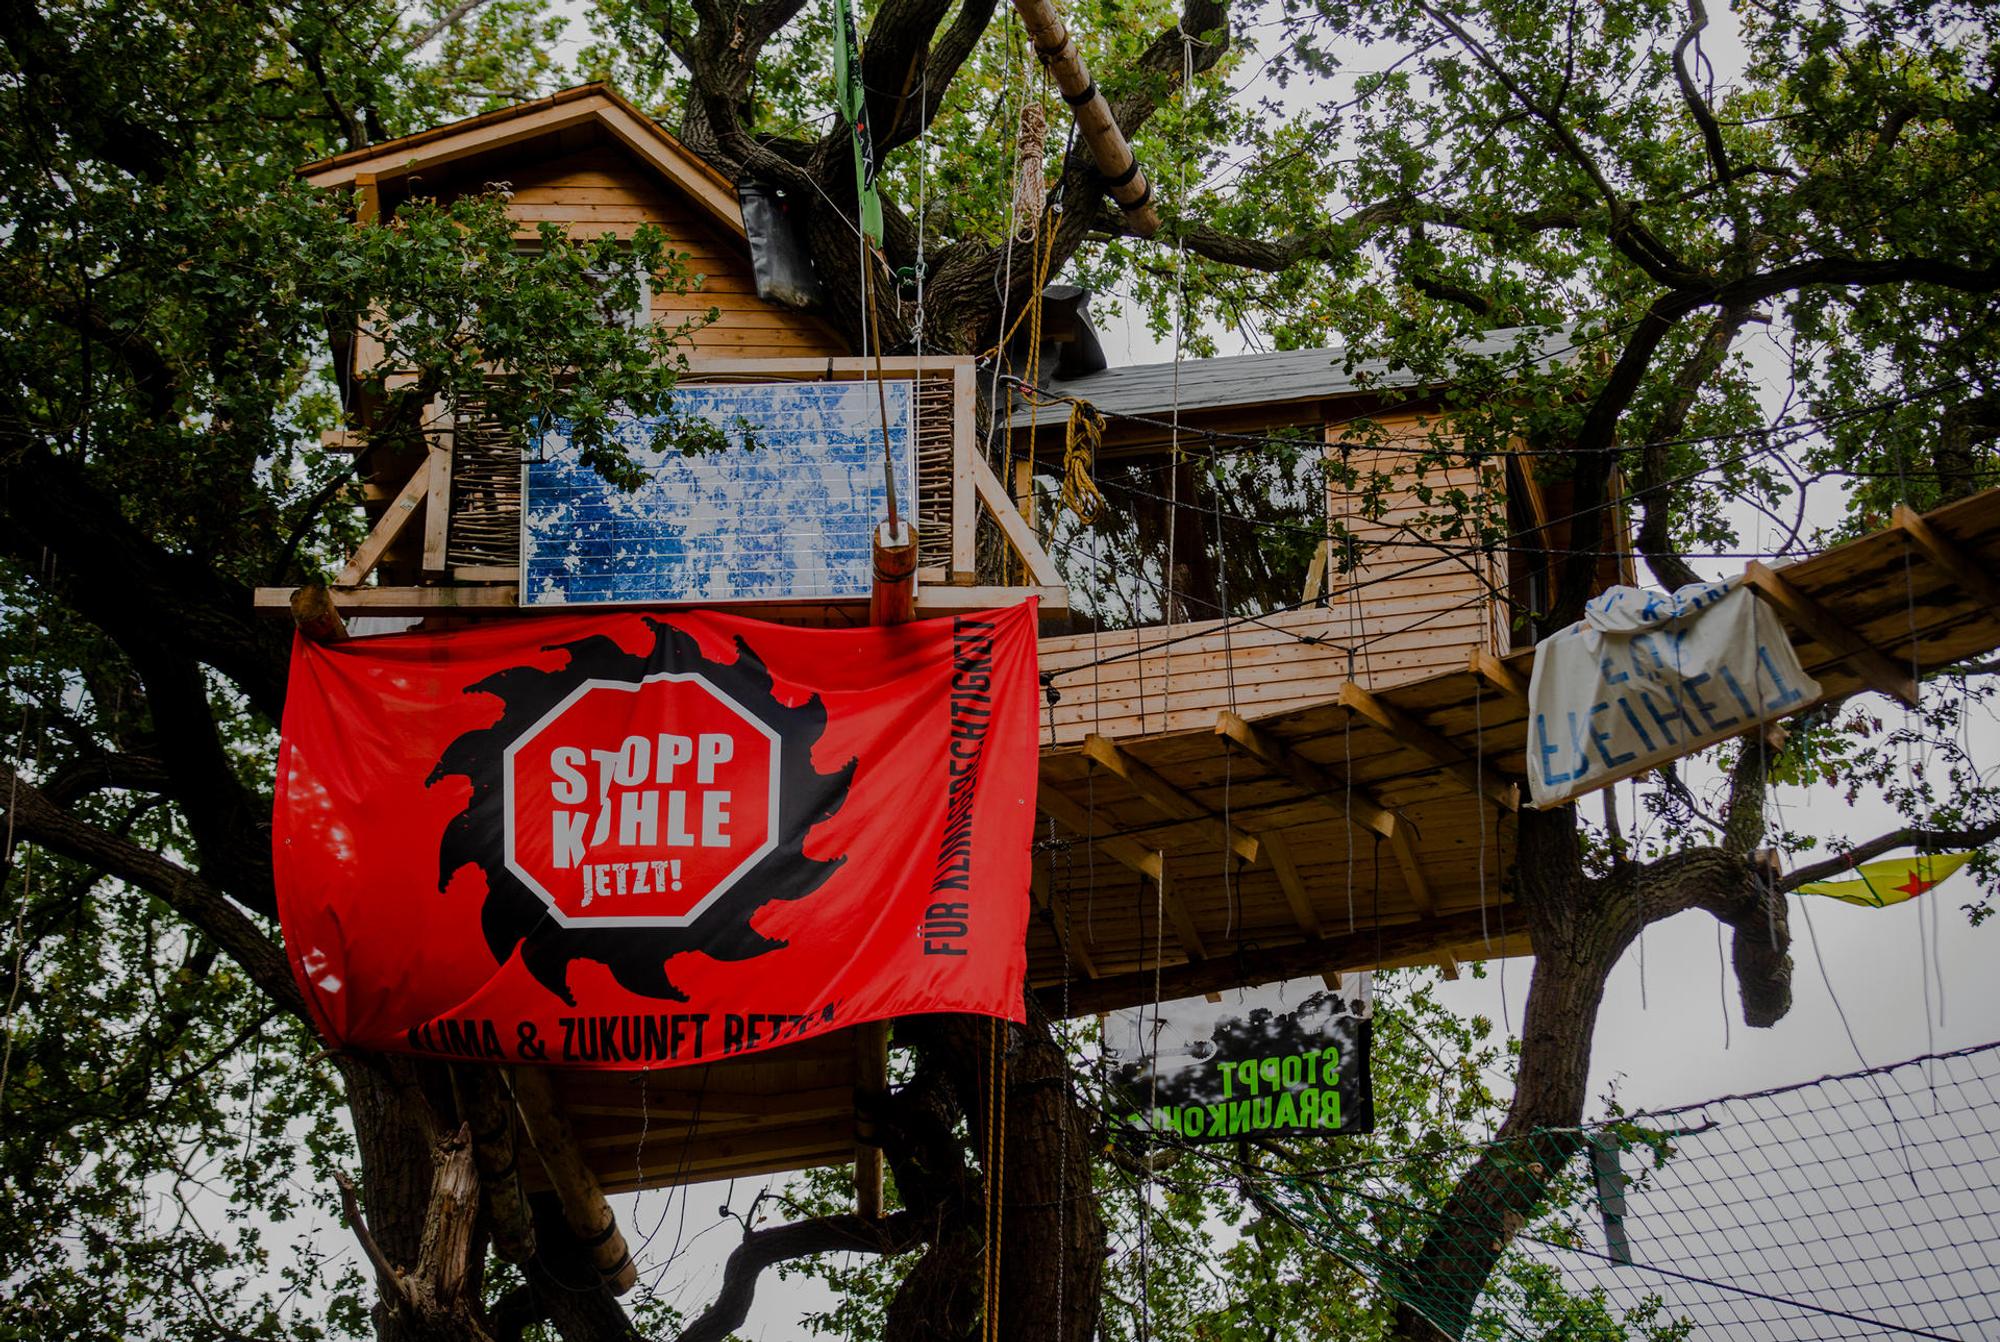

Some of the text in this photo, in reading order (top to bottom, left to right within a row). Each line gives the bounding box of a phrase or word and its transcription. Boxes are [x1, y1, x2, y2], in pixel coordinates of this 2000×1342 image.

[551, 733, 734, 805] STOPP
[581, 859, 682, 908] JETZT!
[917, 902, 969, 956] FÜR
[517, 1020, 547, 1061] &
[558, 1013, 709, 1061] ZUKUNFT
